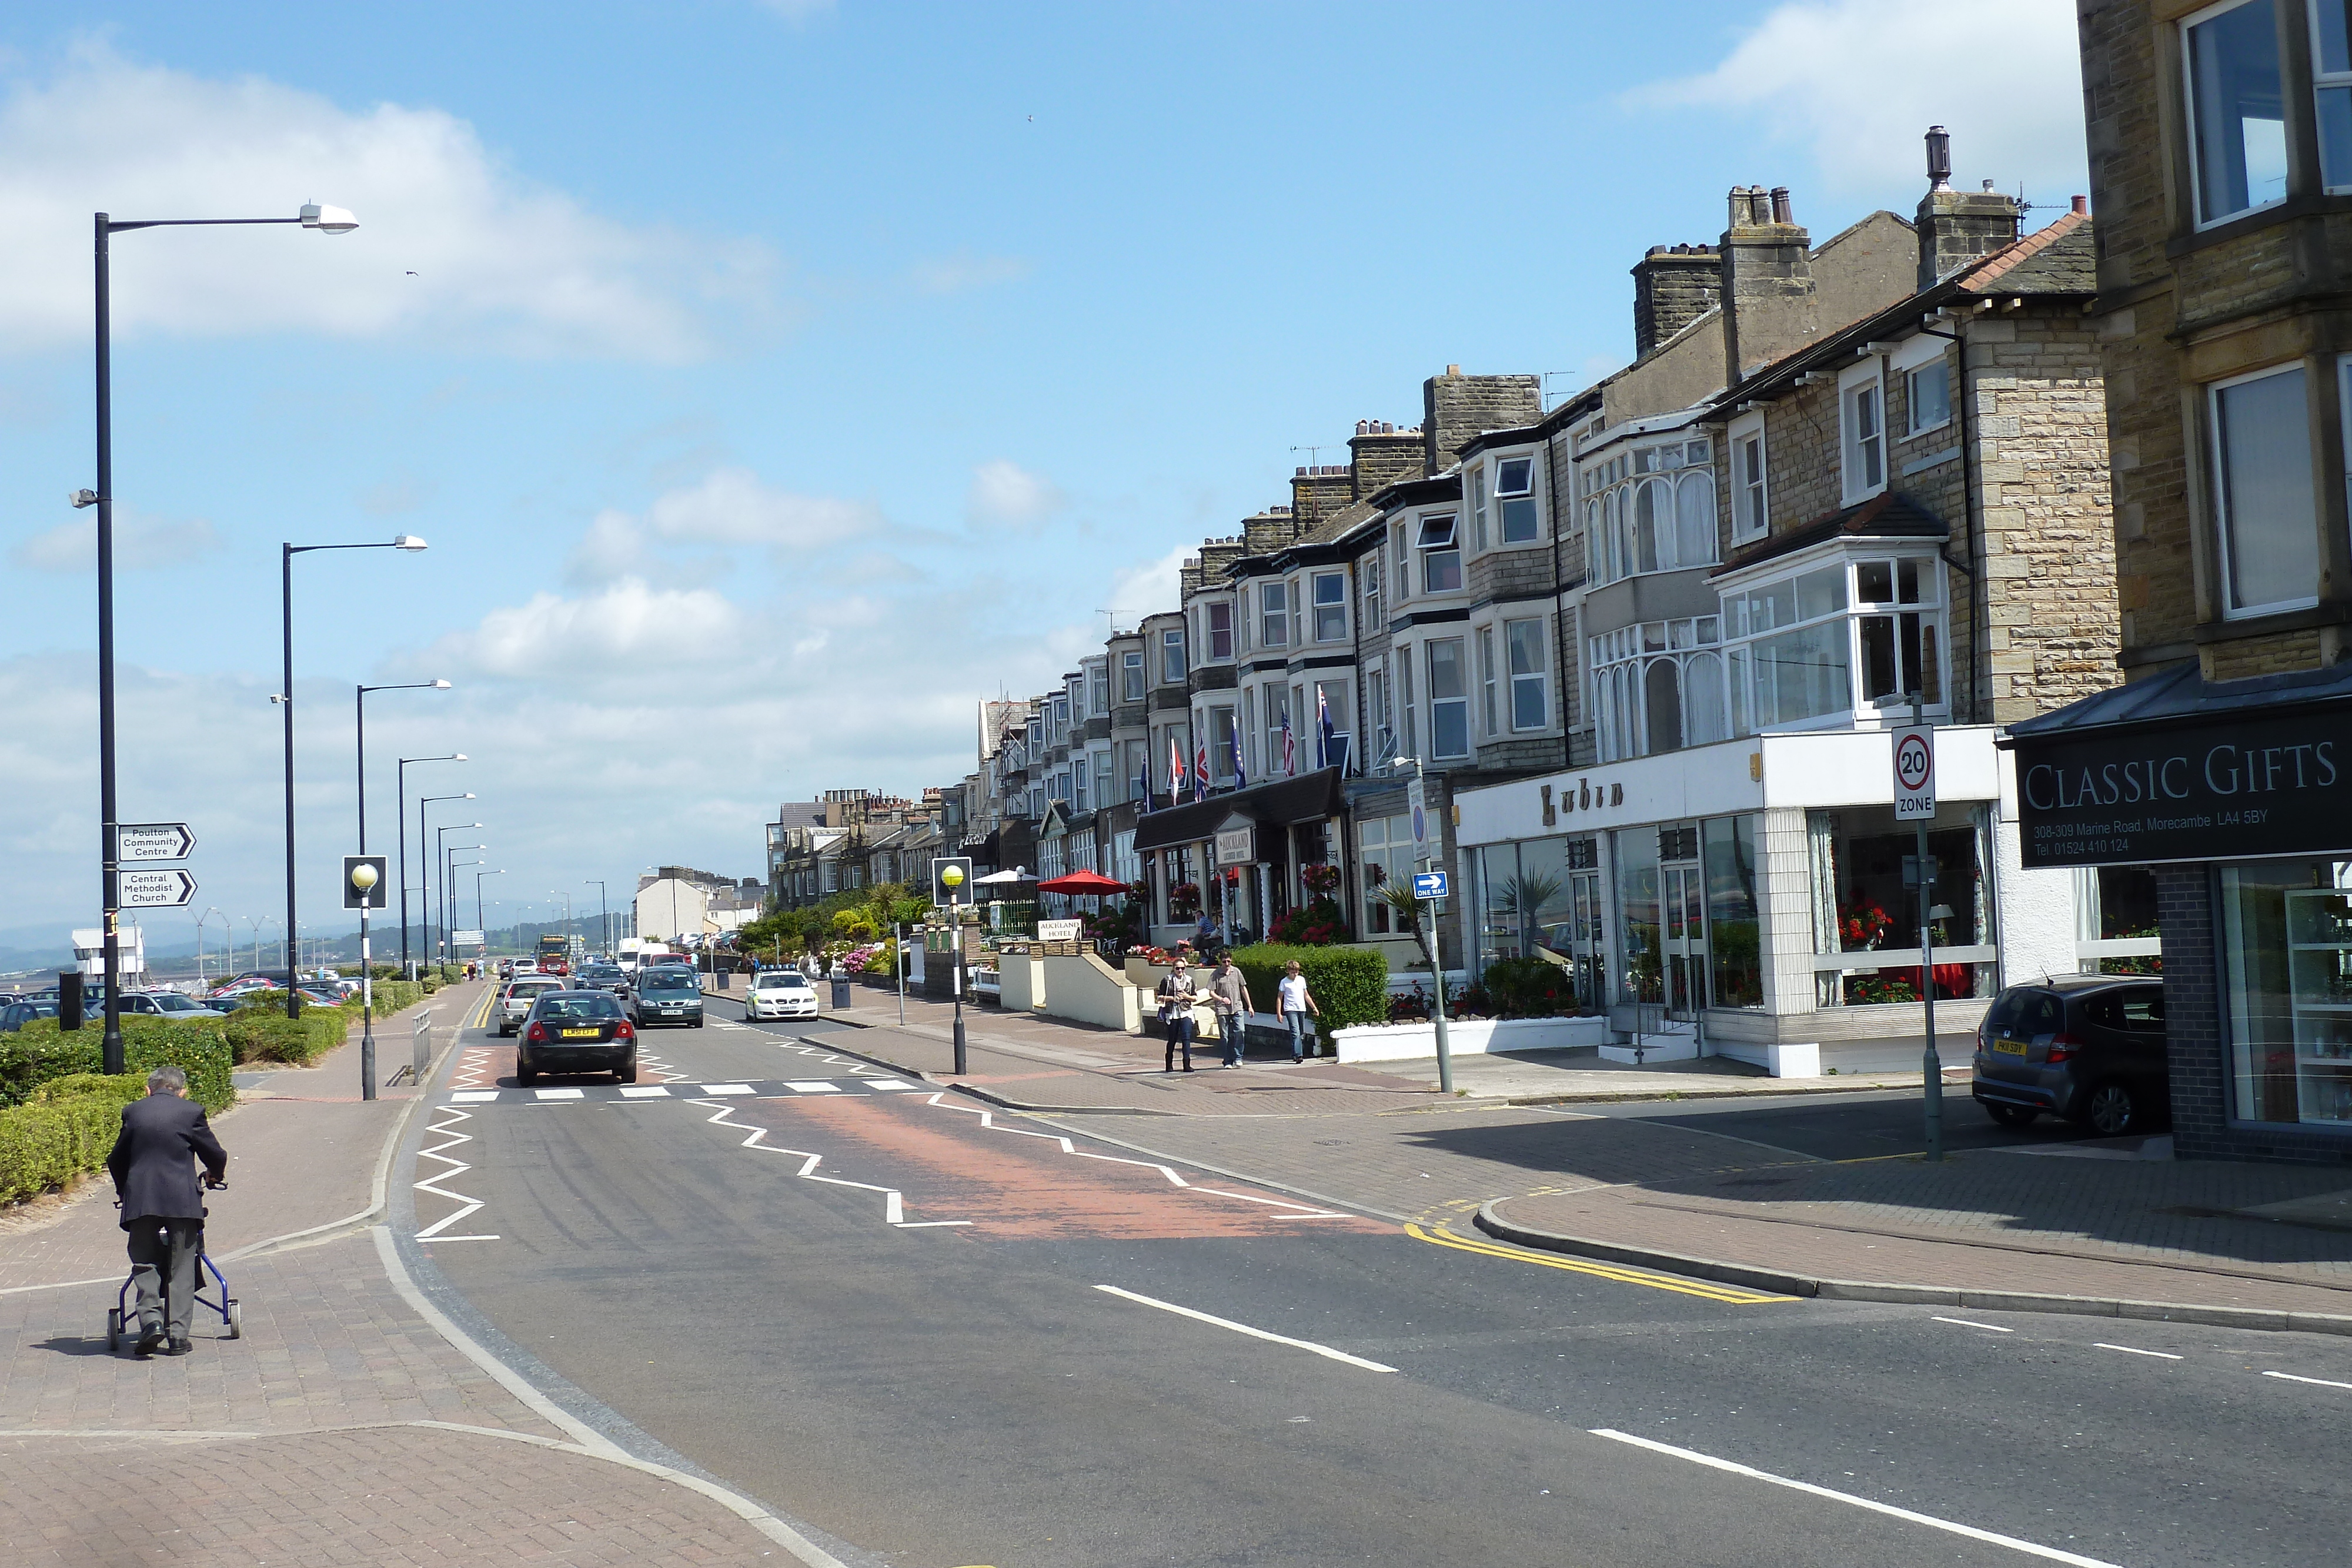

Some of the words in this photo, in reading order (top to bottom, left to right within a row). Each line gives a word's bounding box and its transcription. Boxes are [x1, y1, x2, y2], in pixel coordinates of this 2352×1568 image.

[1901, 750, 1925, 774] 20
[2024, 757, 2189, 811] CLASSIC
[2204, 741, 2337, 795] GIFTS
[1899, 797, 1932, 813] ZONE
[2034, 824, 2074, 839] 308-309
[2076, 823, 2111, 836] Marine
[2113, 819, 2144, 834] Road,
[2147, 814, 2211, 831] Morecambe
[2217, 811, 2240, 825] LA4
[2243, 809, 2269, 824] 5BY
[132, 828, 169, 837] Poulton
[123, 837, 178, 847] Community
[1222, 833, 1248, 851] AUCKLAND
[2054, 841, 2085, 855] 01524
[2087, 839, 2107, 853] 410
[2110, 838, 2129, 852] 124
[135, 848, 168, 856] Centre
[131, 874, 167, 883] Central
[124, 883, 173, 893] Methodist
[132, 894, 167, 902] Church
